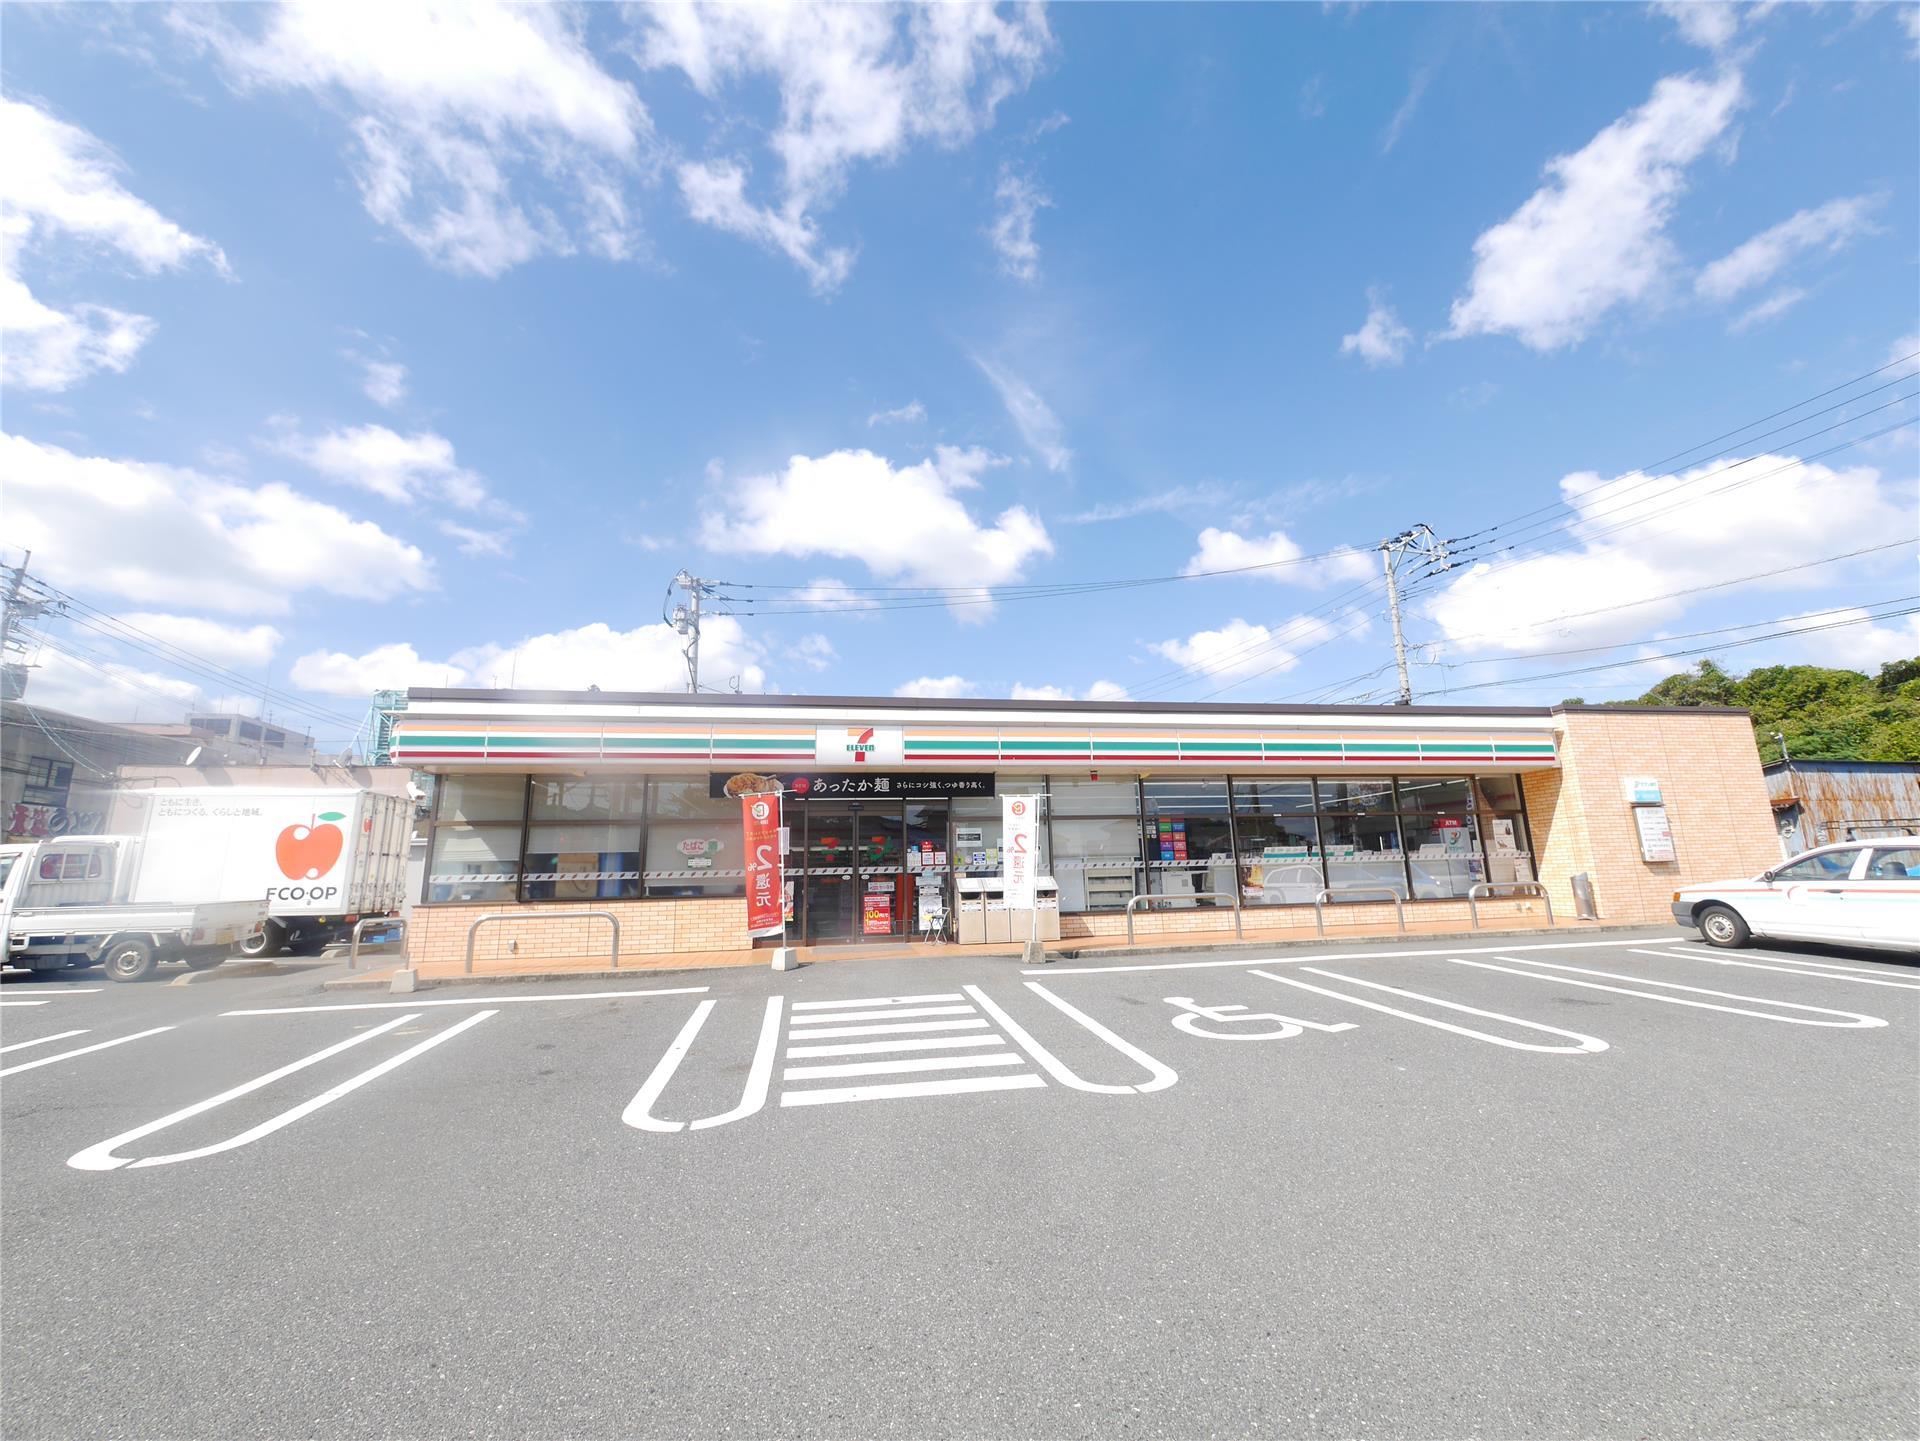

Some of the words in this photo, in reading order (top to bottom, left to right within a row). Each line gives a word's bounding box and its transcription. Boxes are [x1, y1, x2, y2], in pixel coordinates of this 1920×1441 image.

[813, 777, 890, 793] あったか麺
